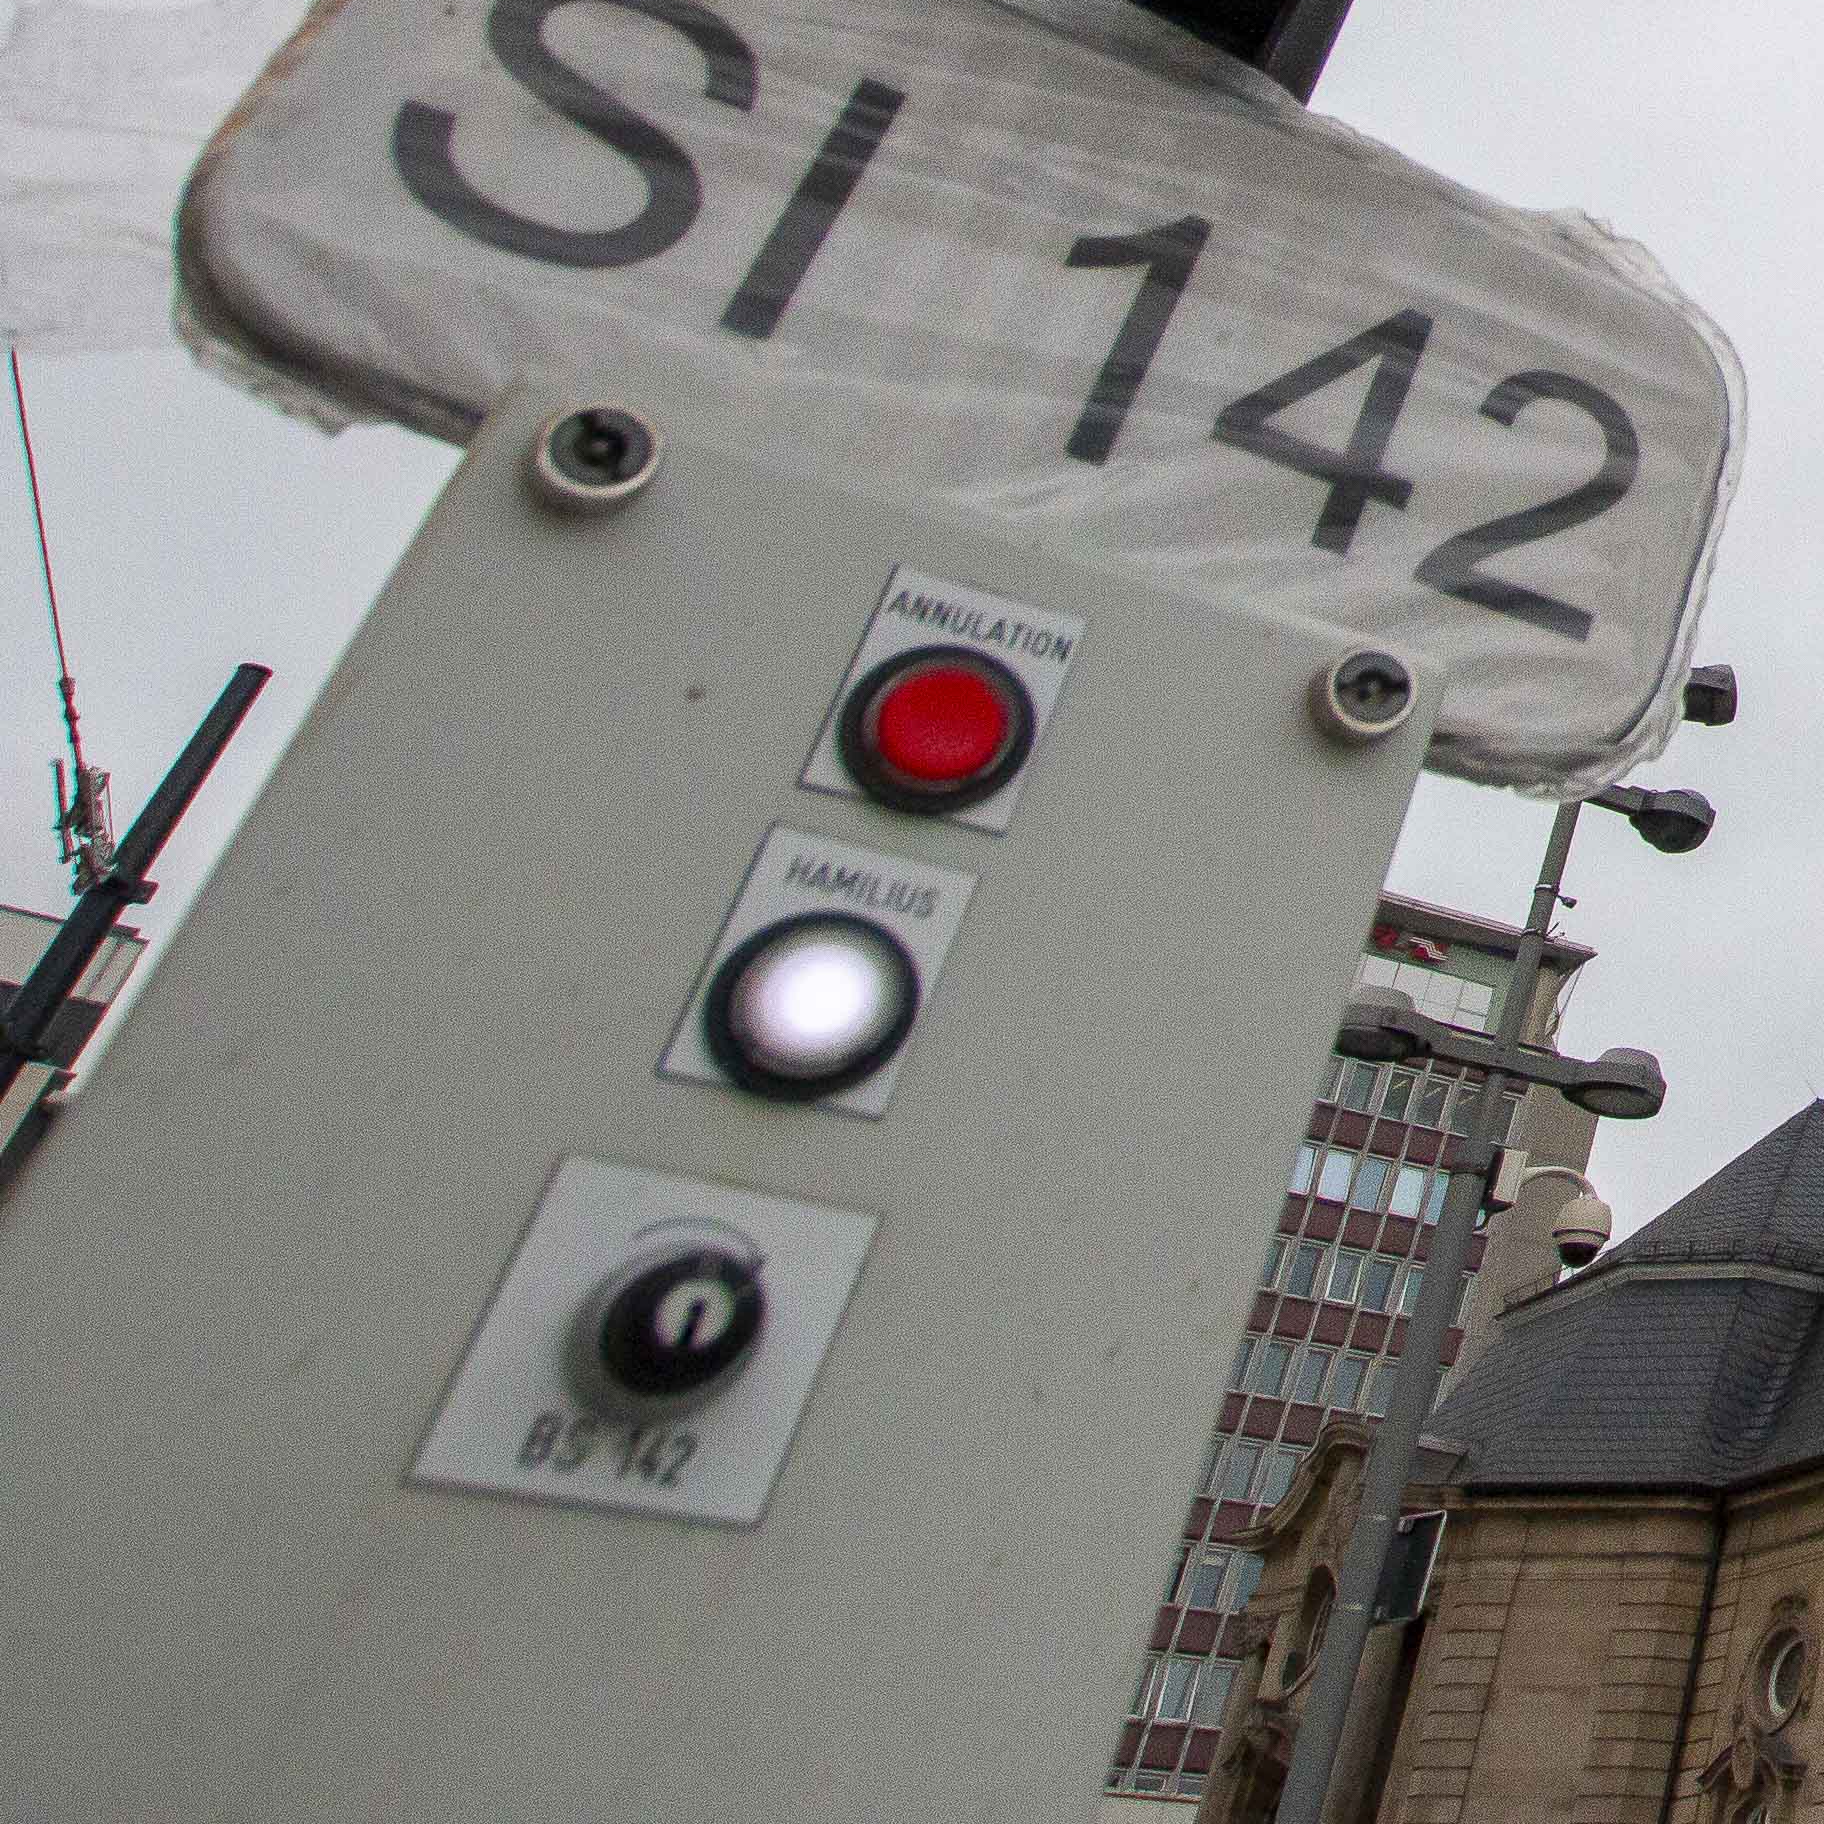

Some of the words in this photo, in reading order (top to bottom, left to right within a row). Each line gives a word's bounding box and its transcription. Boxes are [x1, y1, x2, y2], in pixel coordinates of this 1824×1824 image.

[1065, 215, 1640, 644] 142
[888, 591, 1073, 662] ANNULATION
[784, 856, 939, 919] HAMILIUS
[618, 1426, 699, 1489] 142
